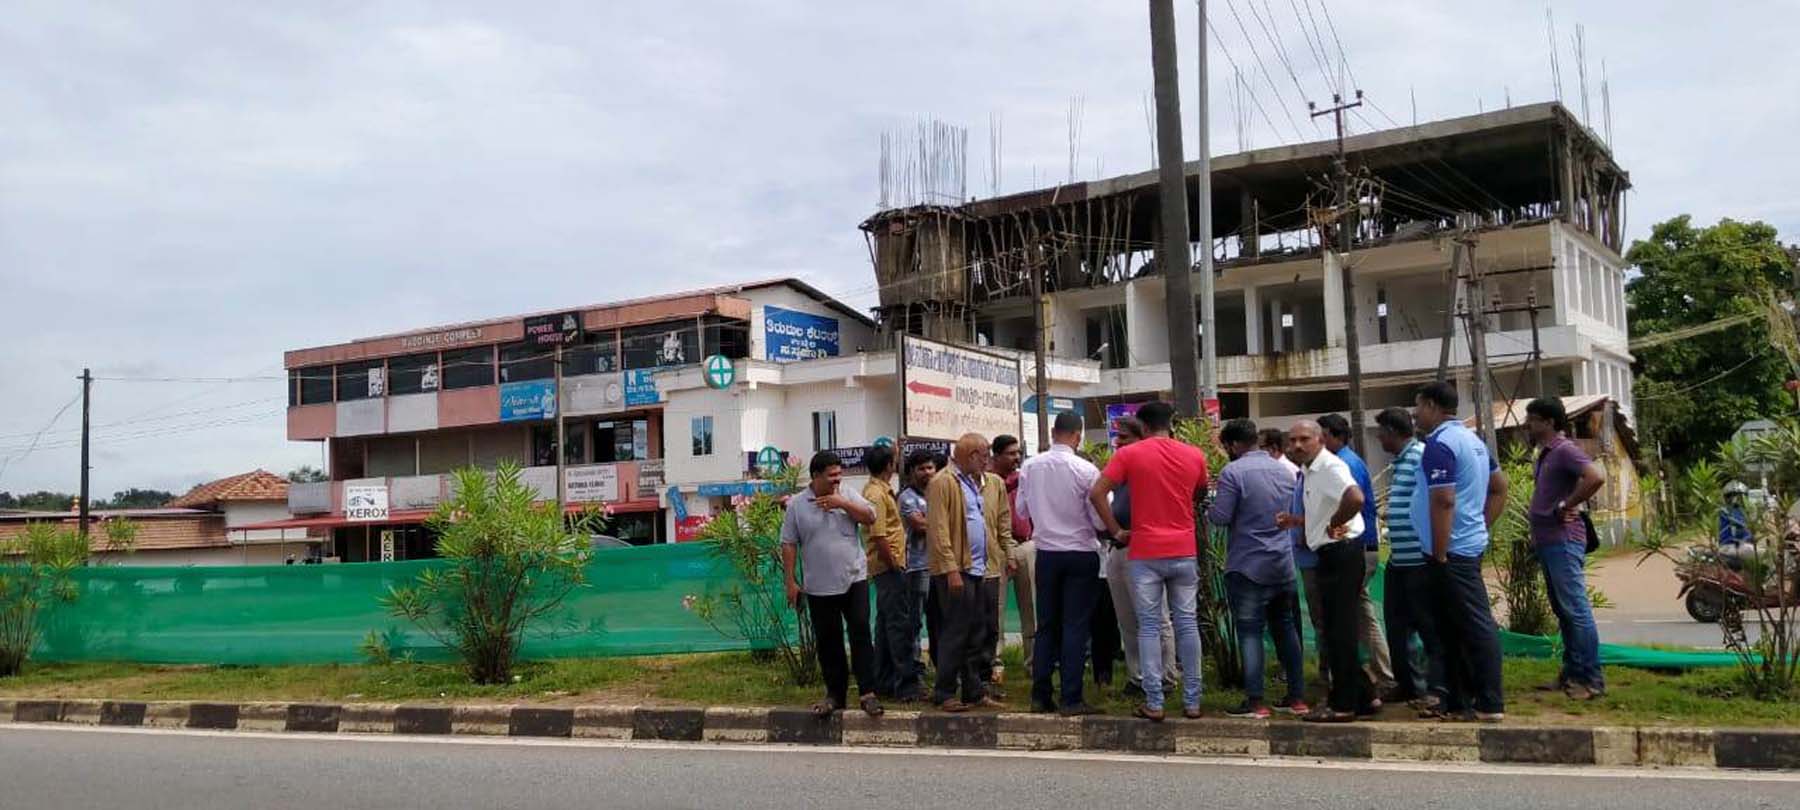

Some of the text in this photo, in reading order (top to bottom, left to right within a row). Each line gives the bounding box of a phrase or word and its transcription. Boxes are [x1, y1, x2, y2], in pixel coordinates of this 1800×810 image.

[528, 324, 554, 334] POWER
[537, 333, 563, 344] HOUSE
[349, 508, 387, 518] XEROX
